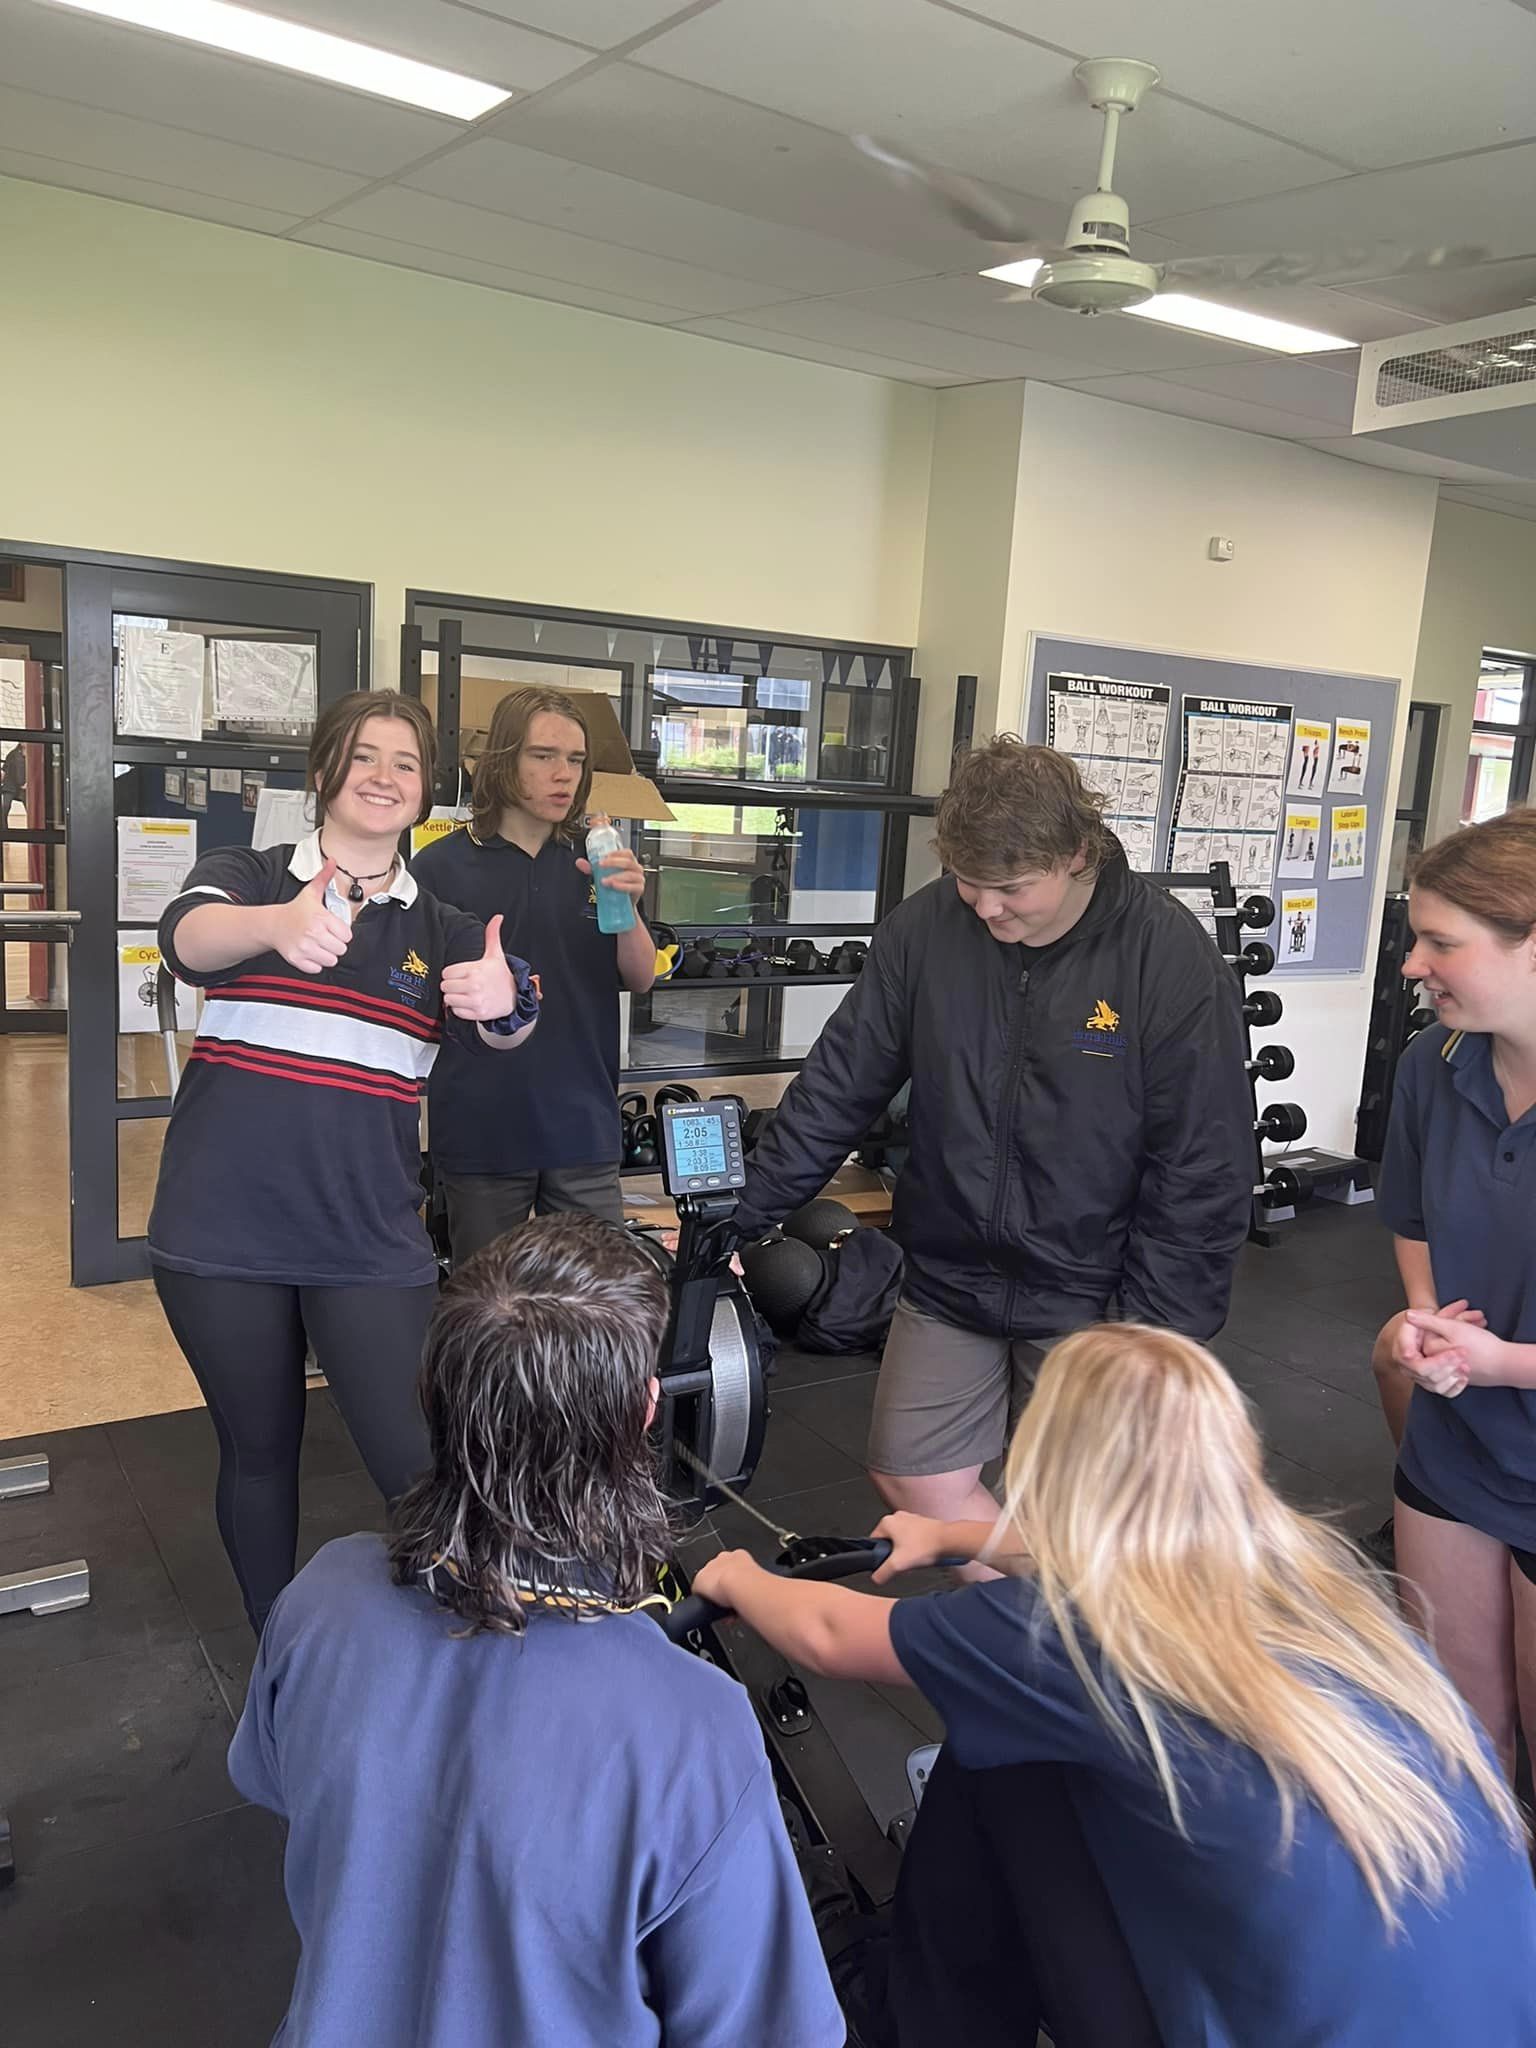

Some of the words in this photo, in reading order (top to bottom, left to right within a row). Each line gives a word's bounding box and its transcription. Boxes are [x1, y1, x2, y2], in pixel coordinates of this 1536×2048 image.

[1067, 680, 1096, 693] BALL
[1098, 683, 1154, 699] WORKOUT
[1200, 700, 1226, 713] BALL
[1227, 703, 1278, 717] WORKOUT
[423, 822, 455, 832] Kettle
[683, 1127, 708, 1139] 2:05
